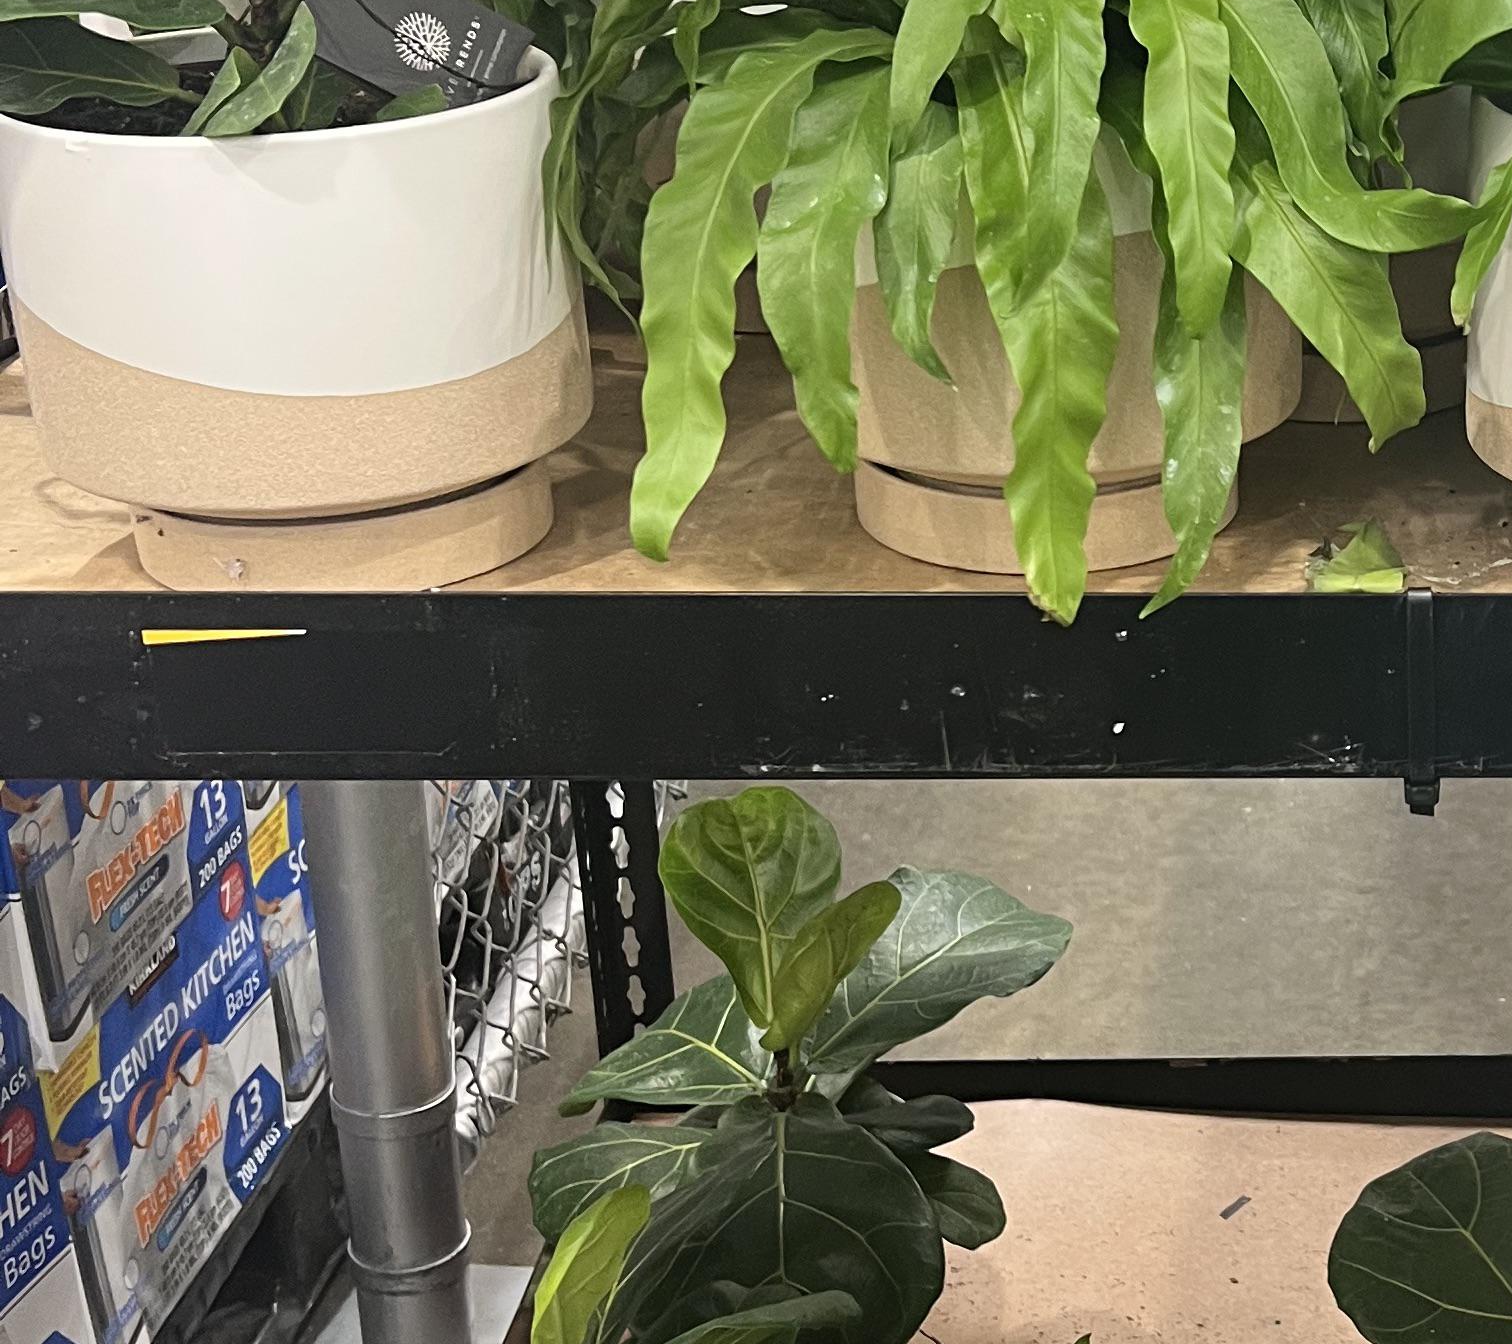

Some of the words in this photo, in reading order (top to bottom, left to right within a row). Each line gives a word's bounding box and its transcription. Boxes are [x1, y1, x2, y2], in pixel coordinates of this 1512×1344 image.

[200, 780, 227, 829] 13
[199, 856, 217, 888] 200
[218, 825, 243, 867] BAGS
[98, 1002, 179, 1121] SCENTED
[180, 911, 255, 1020] KITCHEN
[225, 968, 261, 1021] Bags
[235, 1078, 263, 1133] 13
[237, 1157, 258, 1189] 200
[253, 1121, 281, 1165] BAGS
[4, 1224, 56, 1289] Bags
